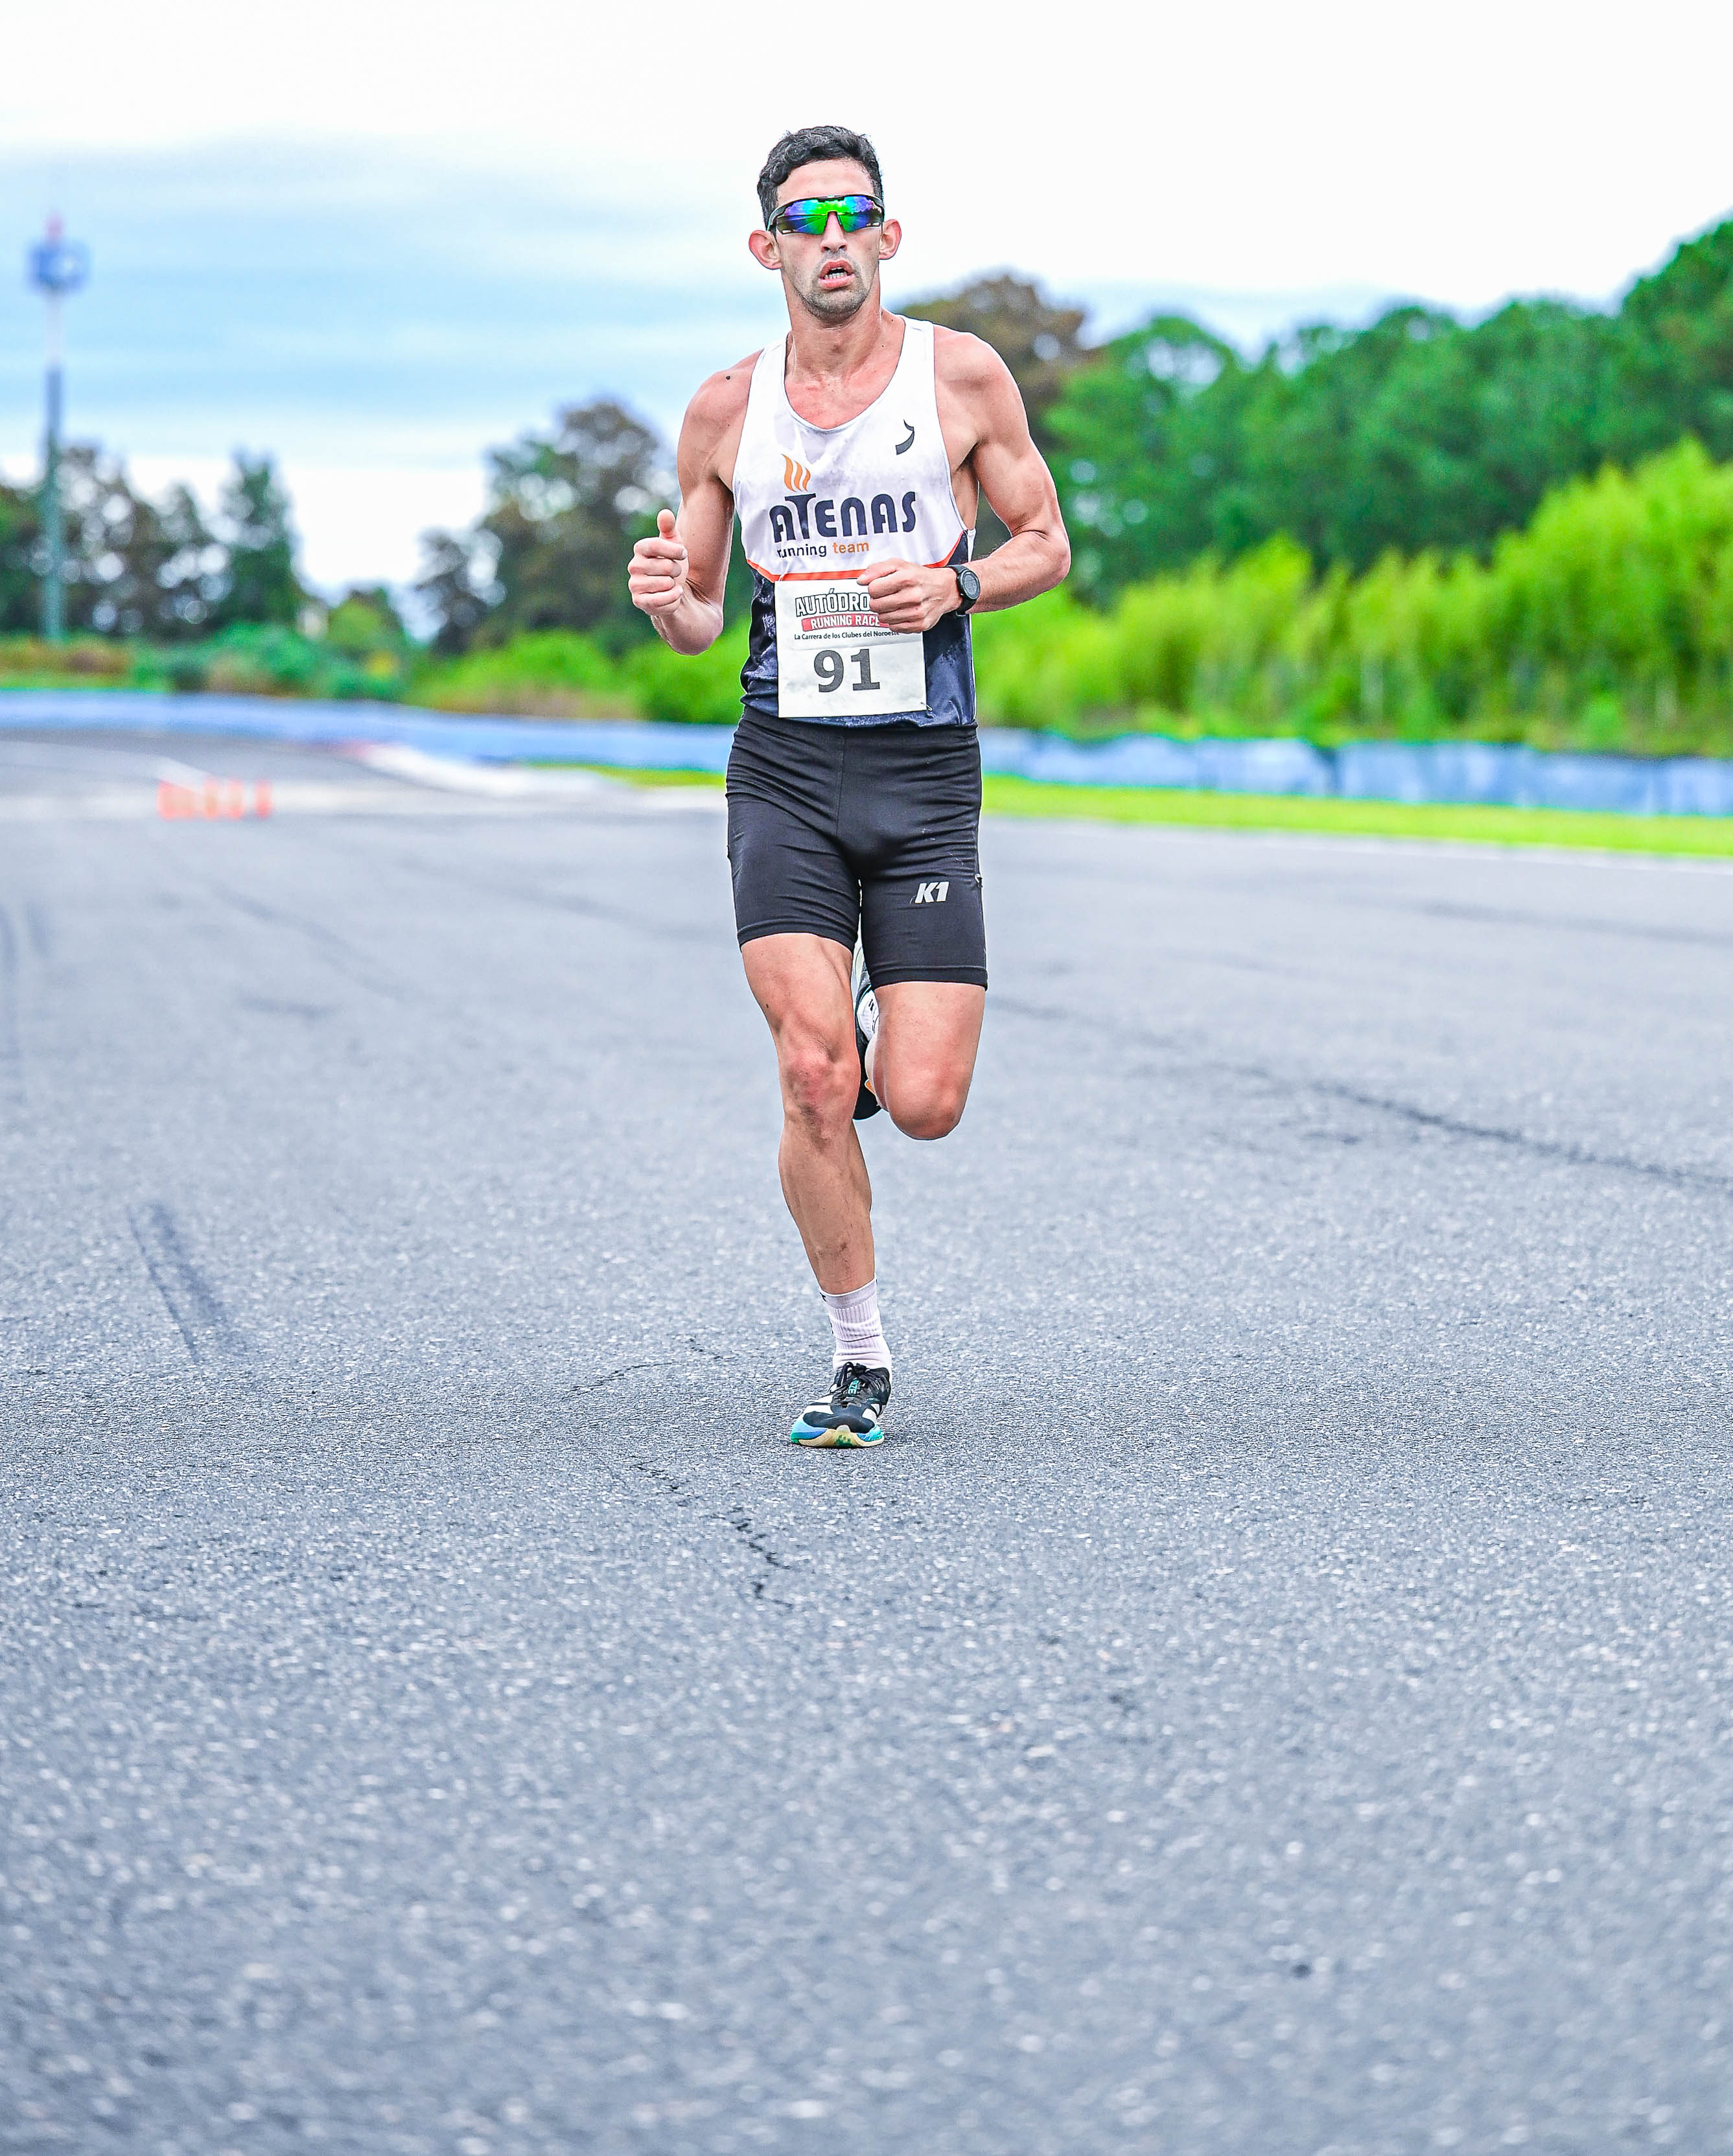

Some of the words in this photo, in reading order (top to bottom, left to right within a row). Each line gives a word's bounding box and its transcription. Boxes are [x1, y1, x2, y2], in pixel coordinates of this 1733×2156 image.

[769, 491, 916, 543] ATENAS
[776, 543, 827, 559] running
[832, 541, 870, 554] team
[795, 587, 871, 617] AUTÓDRO
[810, 615, 852, 629] RUNNING
[855, 615, 880, 627] RACE
[813, 648, 881, 693] 91
[914, 881, 950, 904] K1
